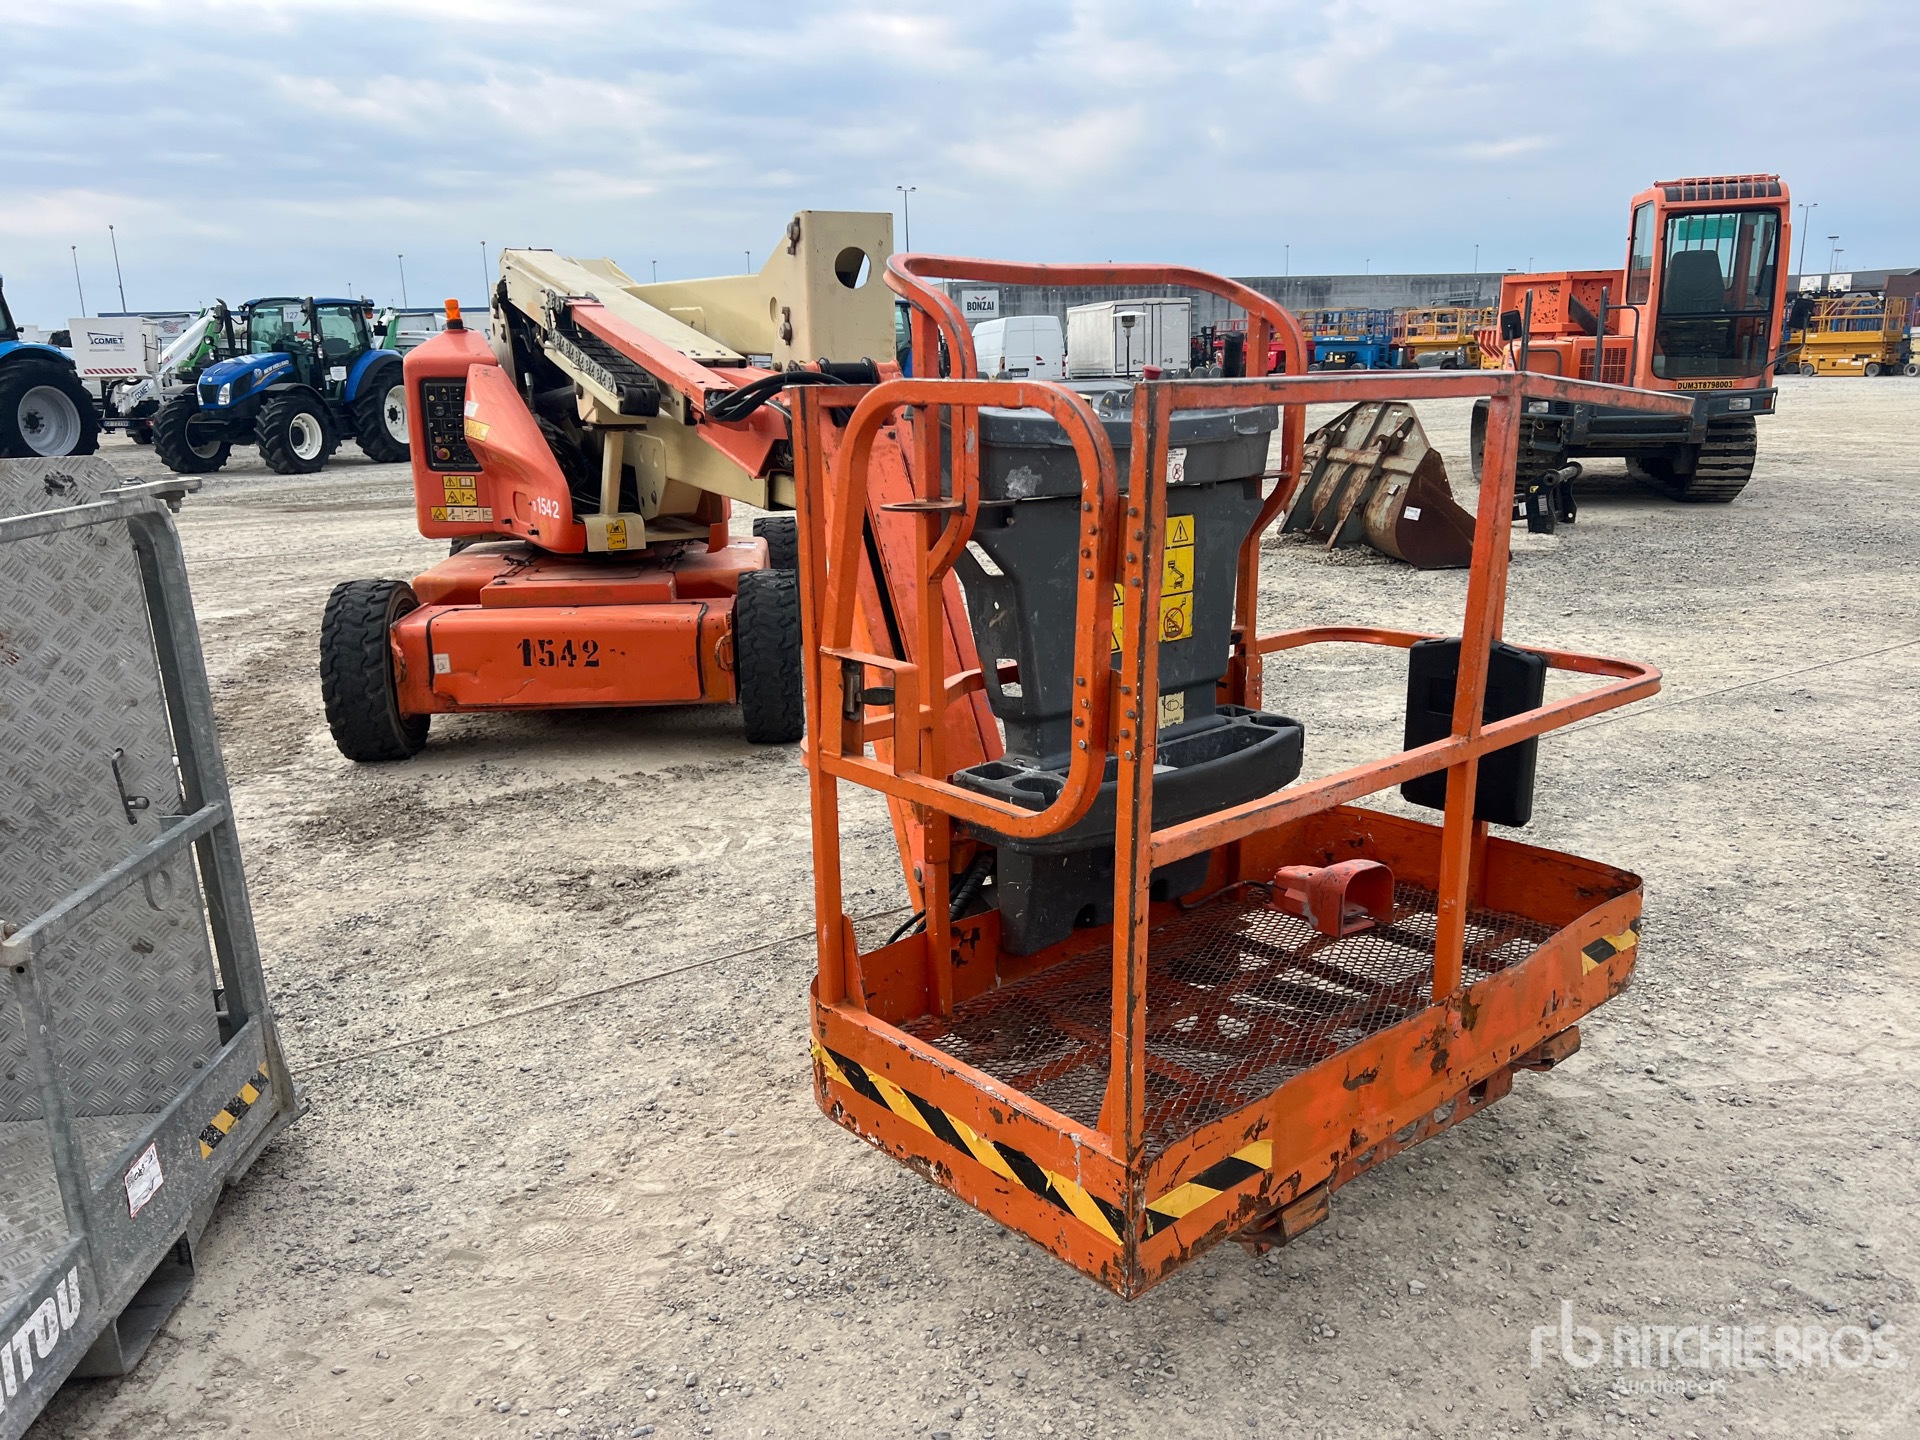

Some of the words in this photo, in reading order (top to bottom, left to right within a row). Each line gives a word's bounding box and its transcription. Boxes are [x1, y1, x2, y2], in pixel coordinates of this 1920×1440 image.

[966, 301, 995, 311] BONZAI
[286, 311, 299, 319] 127
[93, 337, 124, 345] COMET
[1677, 381, 1733, 390] DUM3T8798003
[537, 496, 560, 519] 1542
[517, 638, 600, 667] 1542
